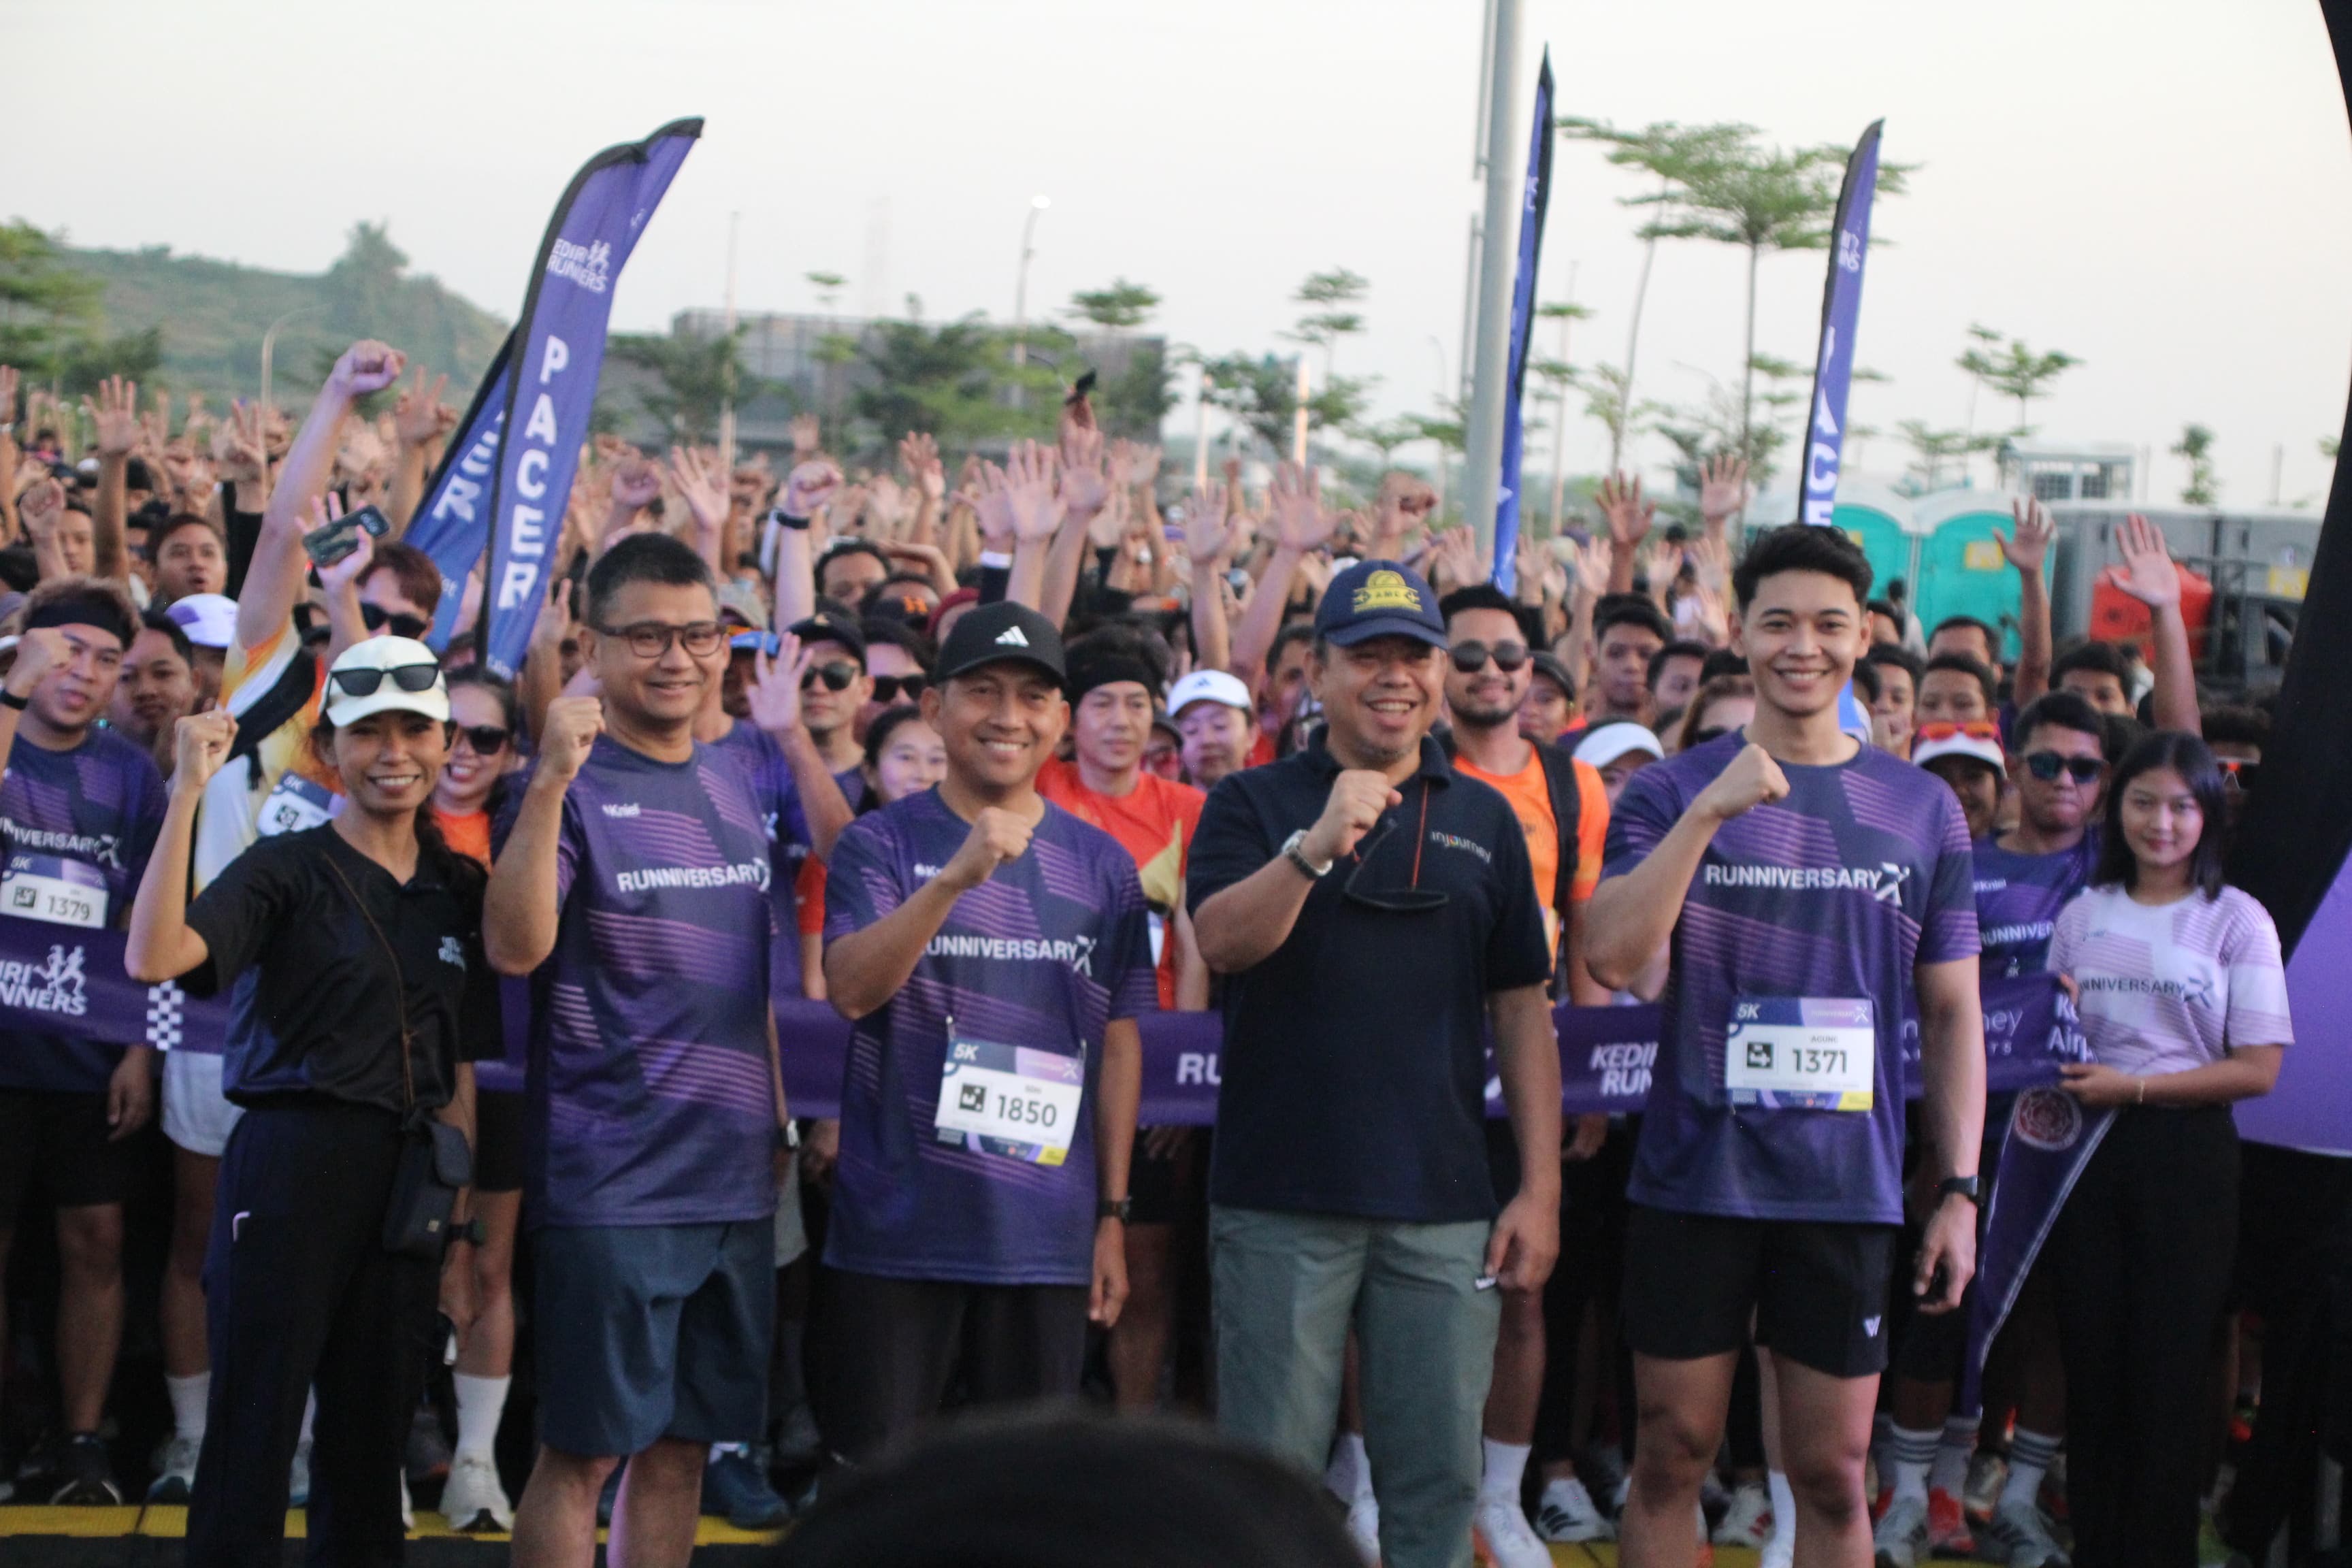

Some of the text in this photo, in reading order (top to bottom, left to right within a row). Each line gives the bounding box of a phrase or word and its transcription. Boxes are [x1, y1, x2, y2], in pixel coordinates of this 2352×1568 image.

[497, 335, 570, 610] PACER
[616, 863, 762, 893] RUNNIVERSARY
[1704, 864, 1882, 890] RUNNIVERSARY
[47, 894, 91, 920] 1379
[1737, 1002, 1761, 1020] 5K
[953, 1043, 979, 1061] 5K
[1792, 1049, 1848, 1073] 1371
[998, 1094, 1057, 1128] 1850
